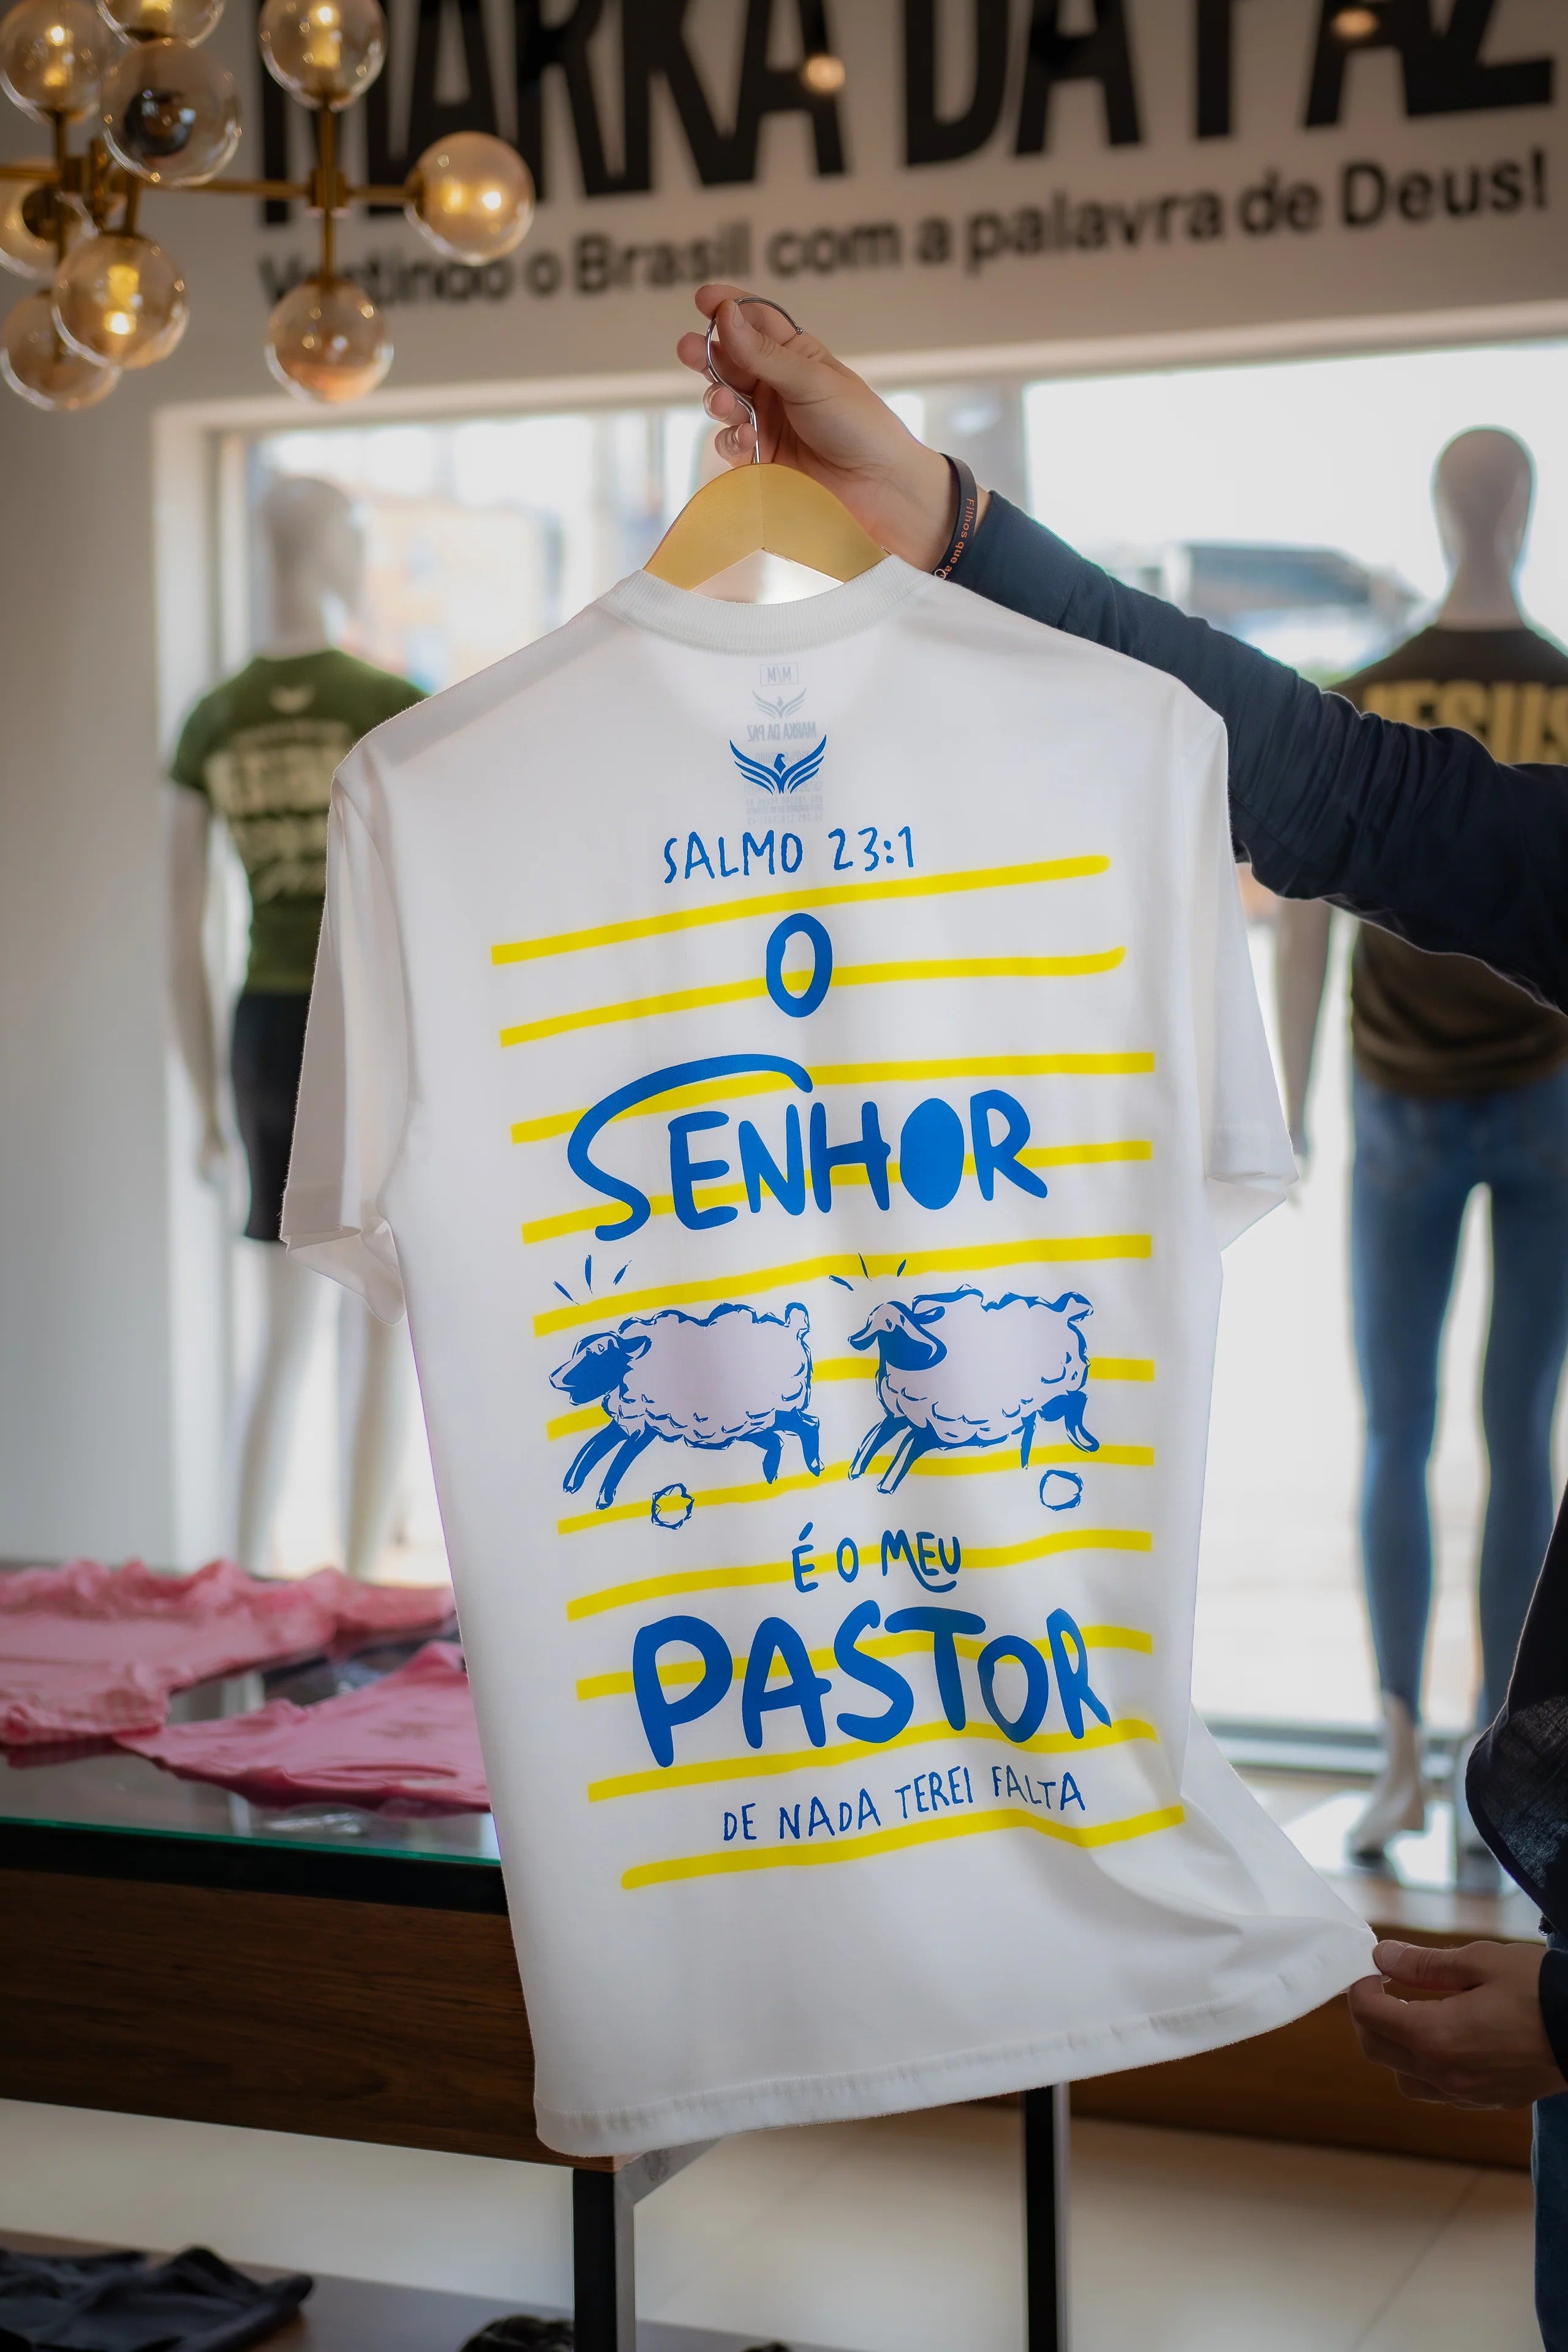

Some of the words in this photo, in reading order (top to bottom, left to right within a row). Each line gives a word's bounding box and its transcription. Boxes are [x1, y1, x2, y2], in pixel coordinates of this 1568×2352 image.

[574, 219, 751, 294] Brasil
[766, 223, 902, 279] com
[915, 214, 951, 265] a
[966, 189, 1224, 274] palavra
[1237, 168, 1322, 235] de
[1341, 149, 1547, 228] Deus!
[951, 541, 964, 564] que
[960, 498, 974, 538] Filhos
[664, 829, 803, 884] SALMO
[827, 826, 914, 872] 23:1
[766, 913, 833, 1018] O
[567, 1054, 1048, 1242] SENHOR
[791, 1521, 819, 1593] É
[836, 1537, 859, 1583] O
[880, 1529, 961, 1593] MEU
[632, 1599, 1112, 1768] PASTOR
[723, 1803, 758, 1841] DE
[779, 1788, 881, 1840] NADA
[894, 1765, 974, 1819] TEREI
[992, 1765, 1086, 1812] FALTA
